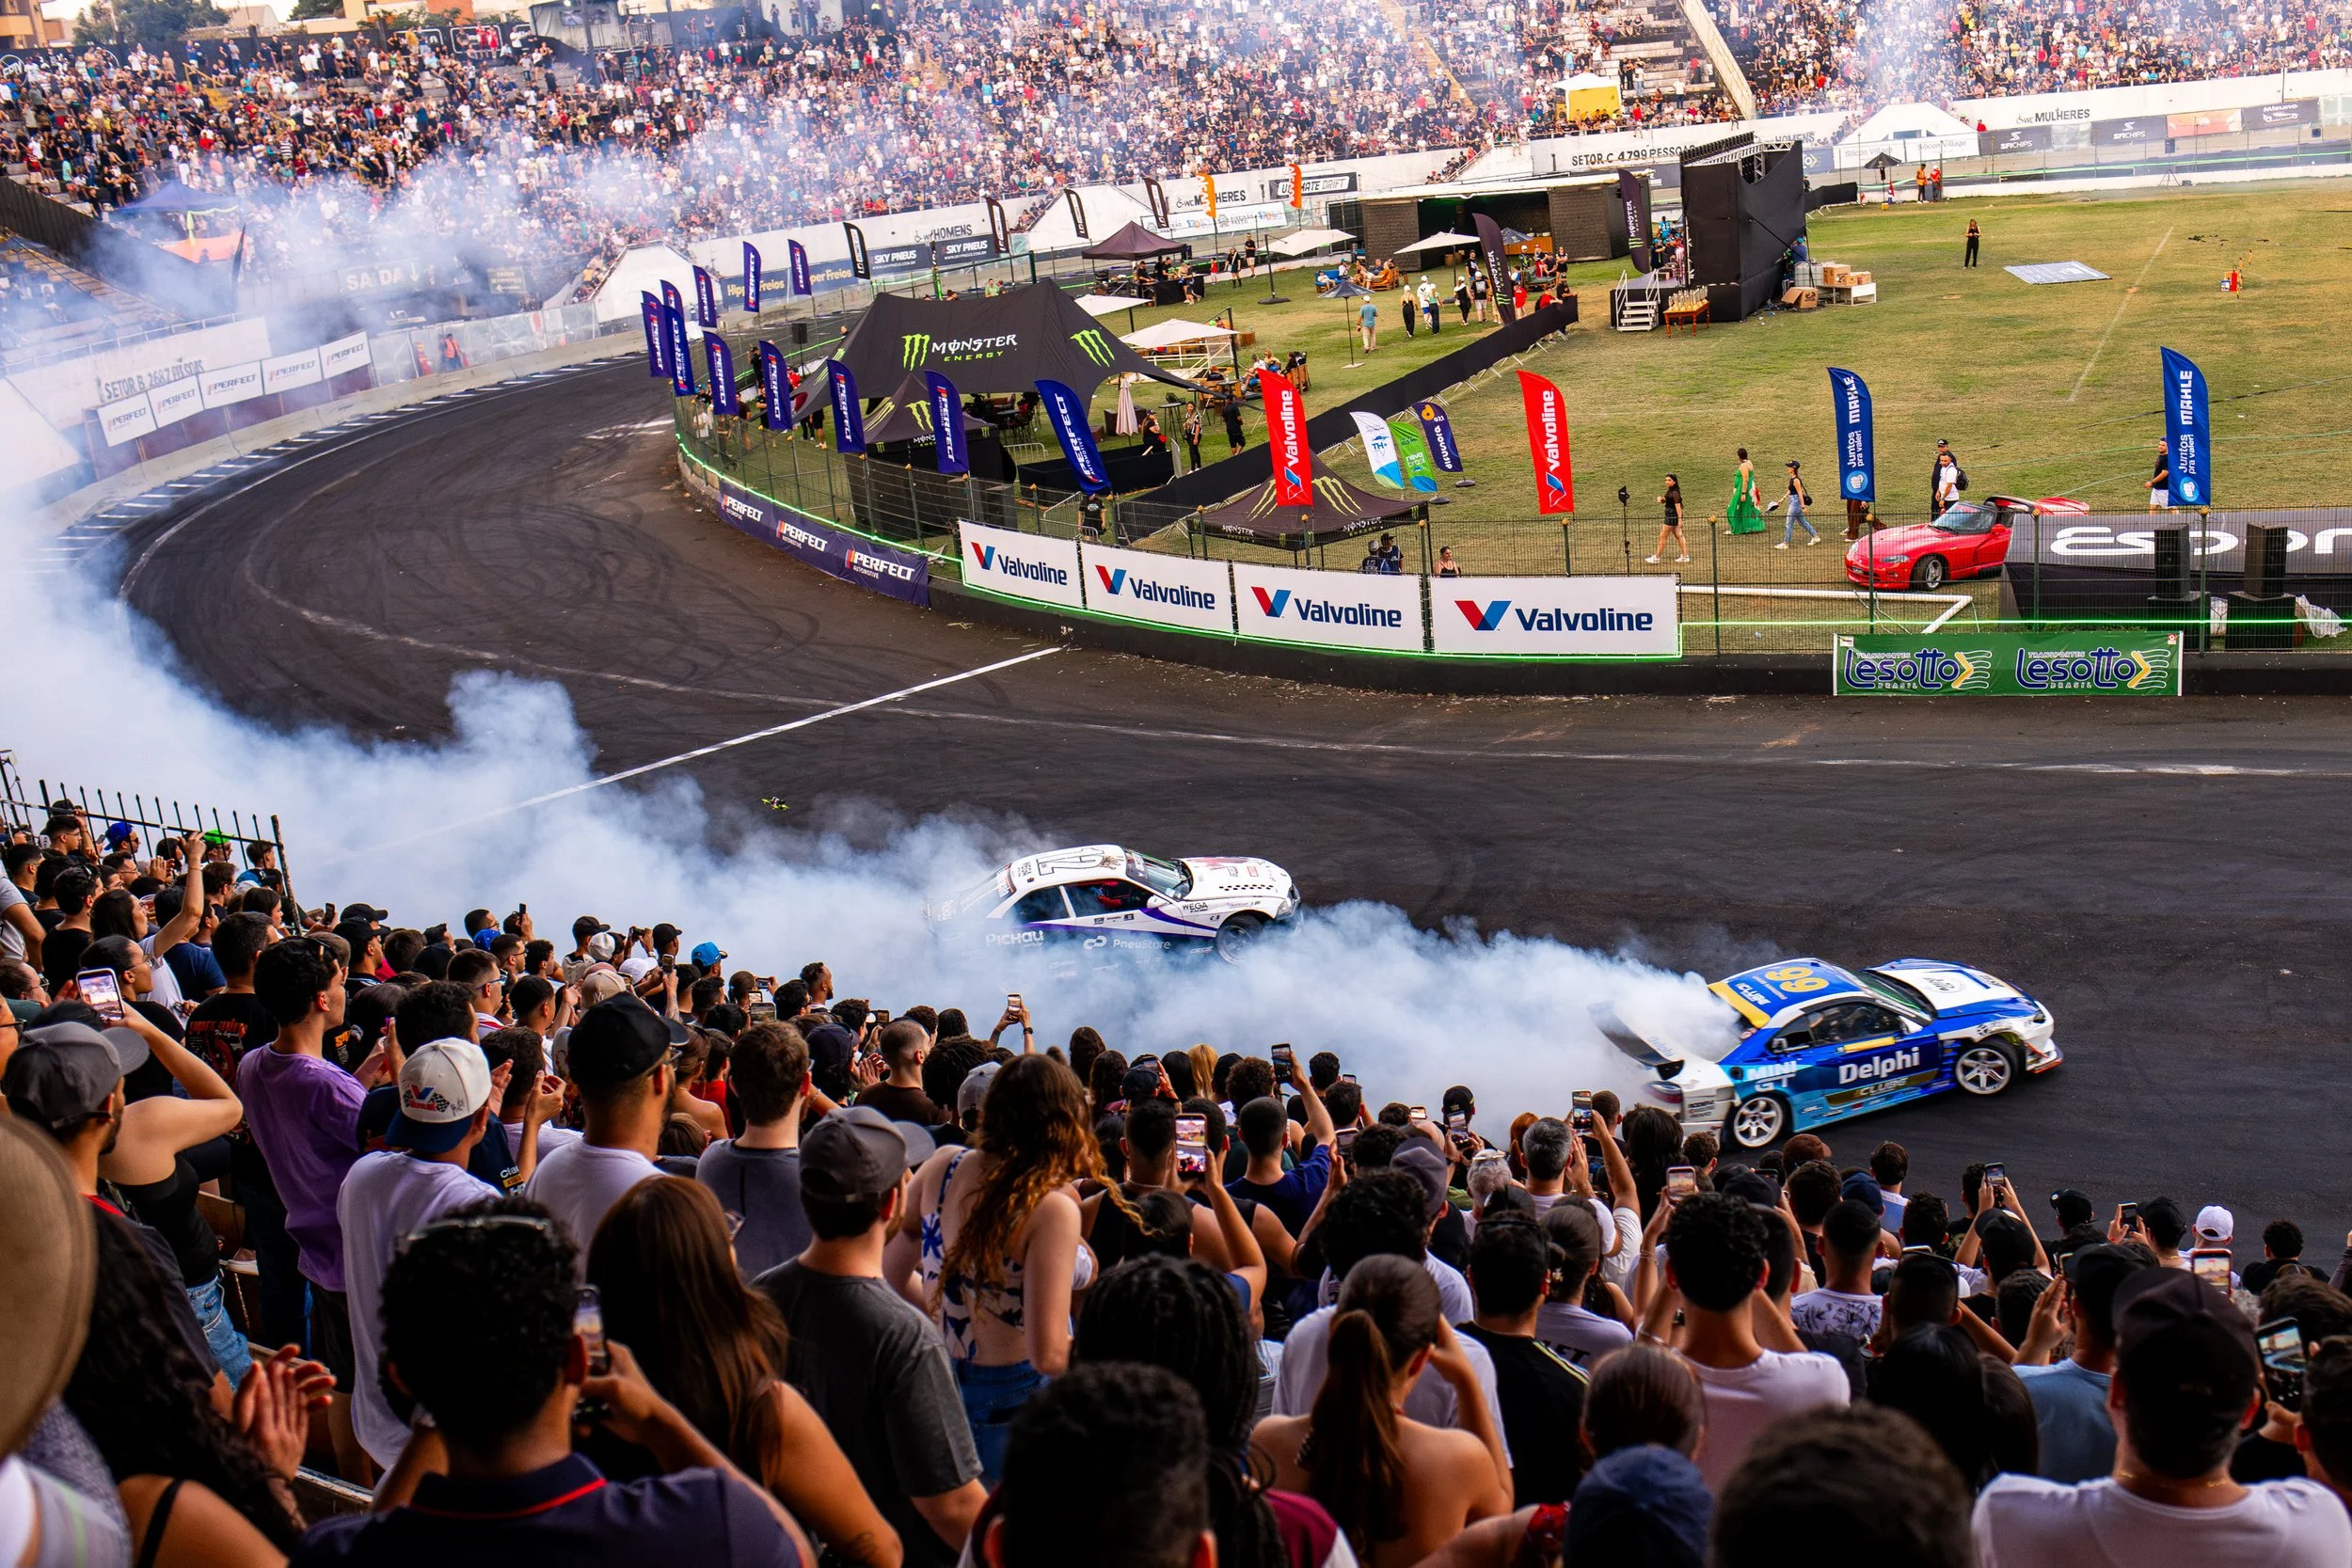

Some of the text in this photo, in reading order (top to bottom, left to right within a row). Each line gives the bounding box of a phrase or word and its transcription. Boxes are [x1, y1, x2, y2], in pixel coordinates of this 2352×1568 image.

[2034, 108, 2090, 123] MULHERES
[1571, 153, 1604, 166] SETOR
[1606, 152, 1613, 164] C
[1617, 150, 1647, 162] 4799
[1321, 178, 1346, 190] DRIFT
[1194, 190, 1247, 206] MHERES
[932, 224, 973, 240] HOMENS
[874, 250, 917, 264] SKY PNEUS
[946, 240, 988, 254] SKY PNEUS
[345, 267, 405, 292] SADA
[794, 253, 805, 290] PERFECT
[826, 268, 852, 281] Freios
[700, 281, 710, 322] PERFECT
[331, 343, 364, 361] PERFECT
[672, 317, 685, 381] PERFECT
[931, 334, 1018, 355] MONSTER
[944, 351, 1004, 362] ENERGY
[276, 360, 315, 377] PERFECT
[715, 352, 727, 406] PERFECT
[214, 373, 256, 391] PERFECT
[771, 362, 782, 421] PERFECT
[162, 388, 196, 407] PERFECT
[1843, 375, 1861, 424] MAHLE
[2180, 370, 2194, 425] MAHLE
[112, 406, 147, 426] PERFECT
[839, 382, 852, 443] PERFECT
[913, 434, 936, 444] MONS
[942, 396, 956, 463] PERFECT
[1054, 393, 1091, 477] PERFECT
[1279, 389, 1299, 467] Valvoline
[1541, 389, 1561, 472] Valvoline
[1076, 436, 1095, 476] AUTOMOTIVE
[1434, 425, 1453, 469] difusora
[1847, 431, 1857, 468] Juntos
[1854, 430, 1866, 467] pra valer!
[2178, 434, 2188, 474] Juntos
[2187, 434, 2197, 475] pra valer!
[726, 496, 764, 522] PERFECT
[782, 523, 828, 552] PERFECT
[852, 565, 880, 579] AUTOMOTIVE
[854, 551, 915, 581] PERFECT
[997, 553, 1068, 586] Valvoline
[1129, 576, 1216, 610] Valvoline
[1294, 596, 1402, 629] Valvoline
[1515, 607, 1654, 632] Valvoline
[1182, 902, 1209, 911] WEGA
[1113, 939, 1171, 950] PneuStore
[1746, 1060, 1798, 1080] MINI
[1838, 1046, 1920, 1085] Delphi
[1754, 1073, 1797, 1093] GT
[500, 1165, 519, 1179] Cla
